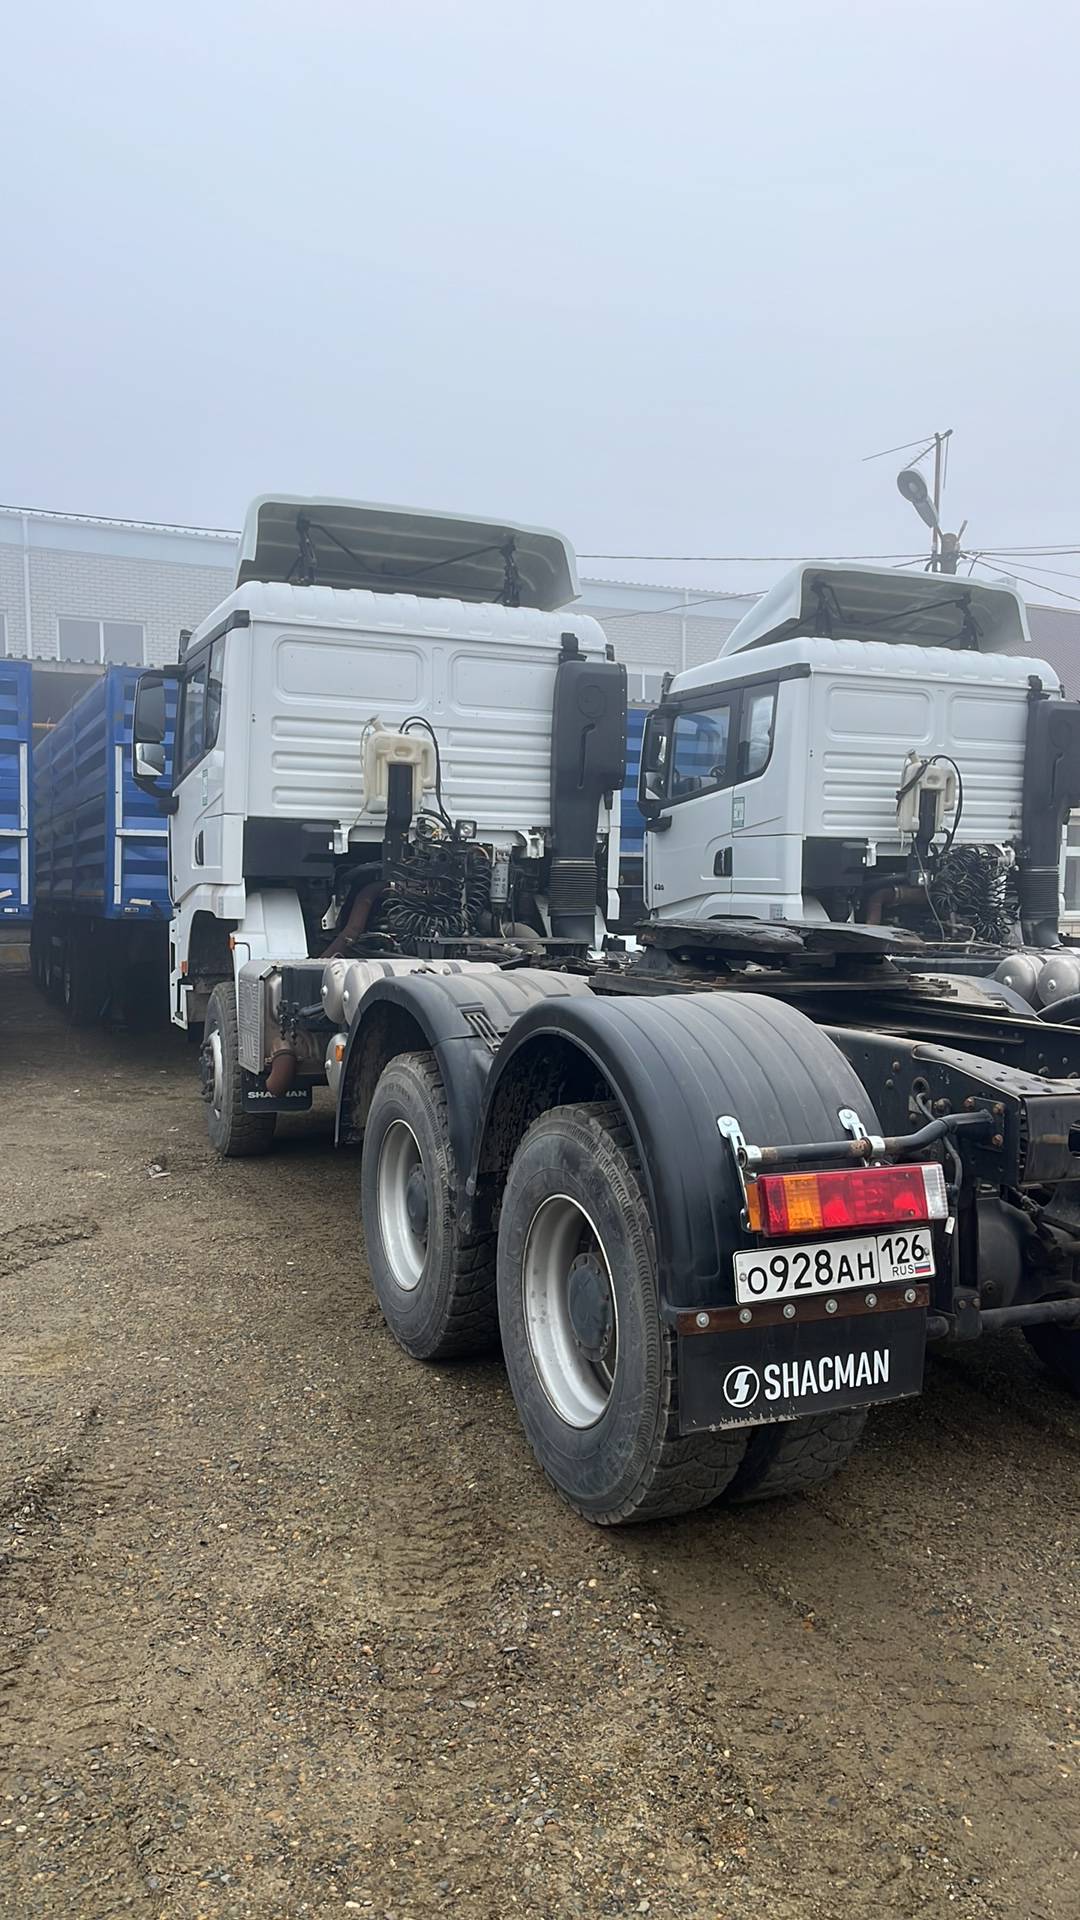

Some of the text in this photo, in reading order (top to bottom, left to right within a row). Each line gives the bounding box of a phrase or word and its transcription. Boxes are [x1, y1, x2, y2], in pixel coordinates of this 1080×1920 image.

[881, 1234, 924, 1265] 126
[892, 1263, 914, 1277] RUS
[764, 1349, 889, 1400] SHACMAN
